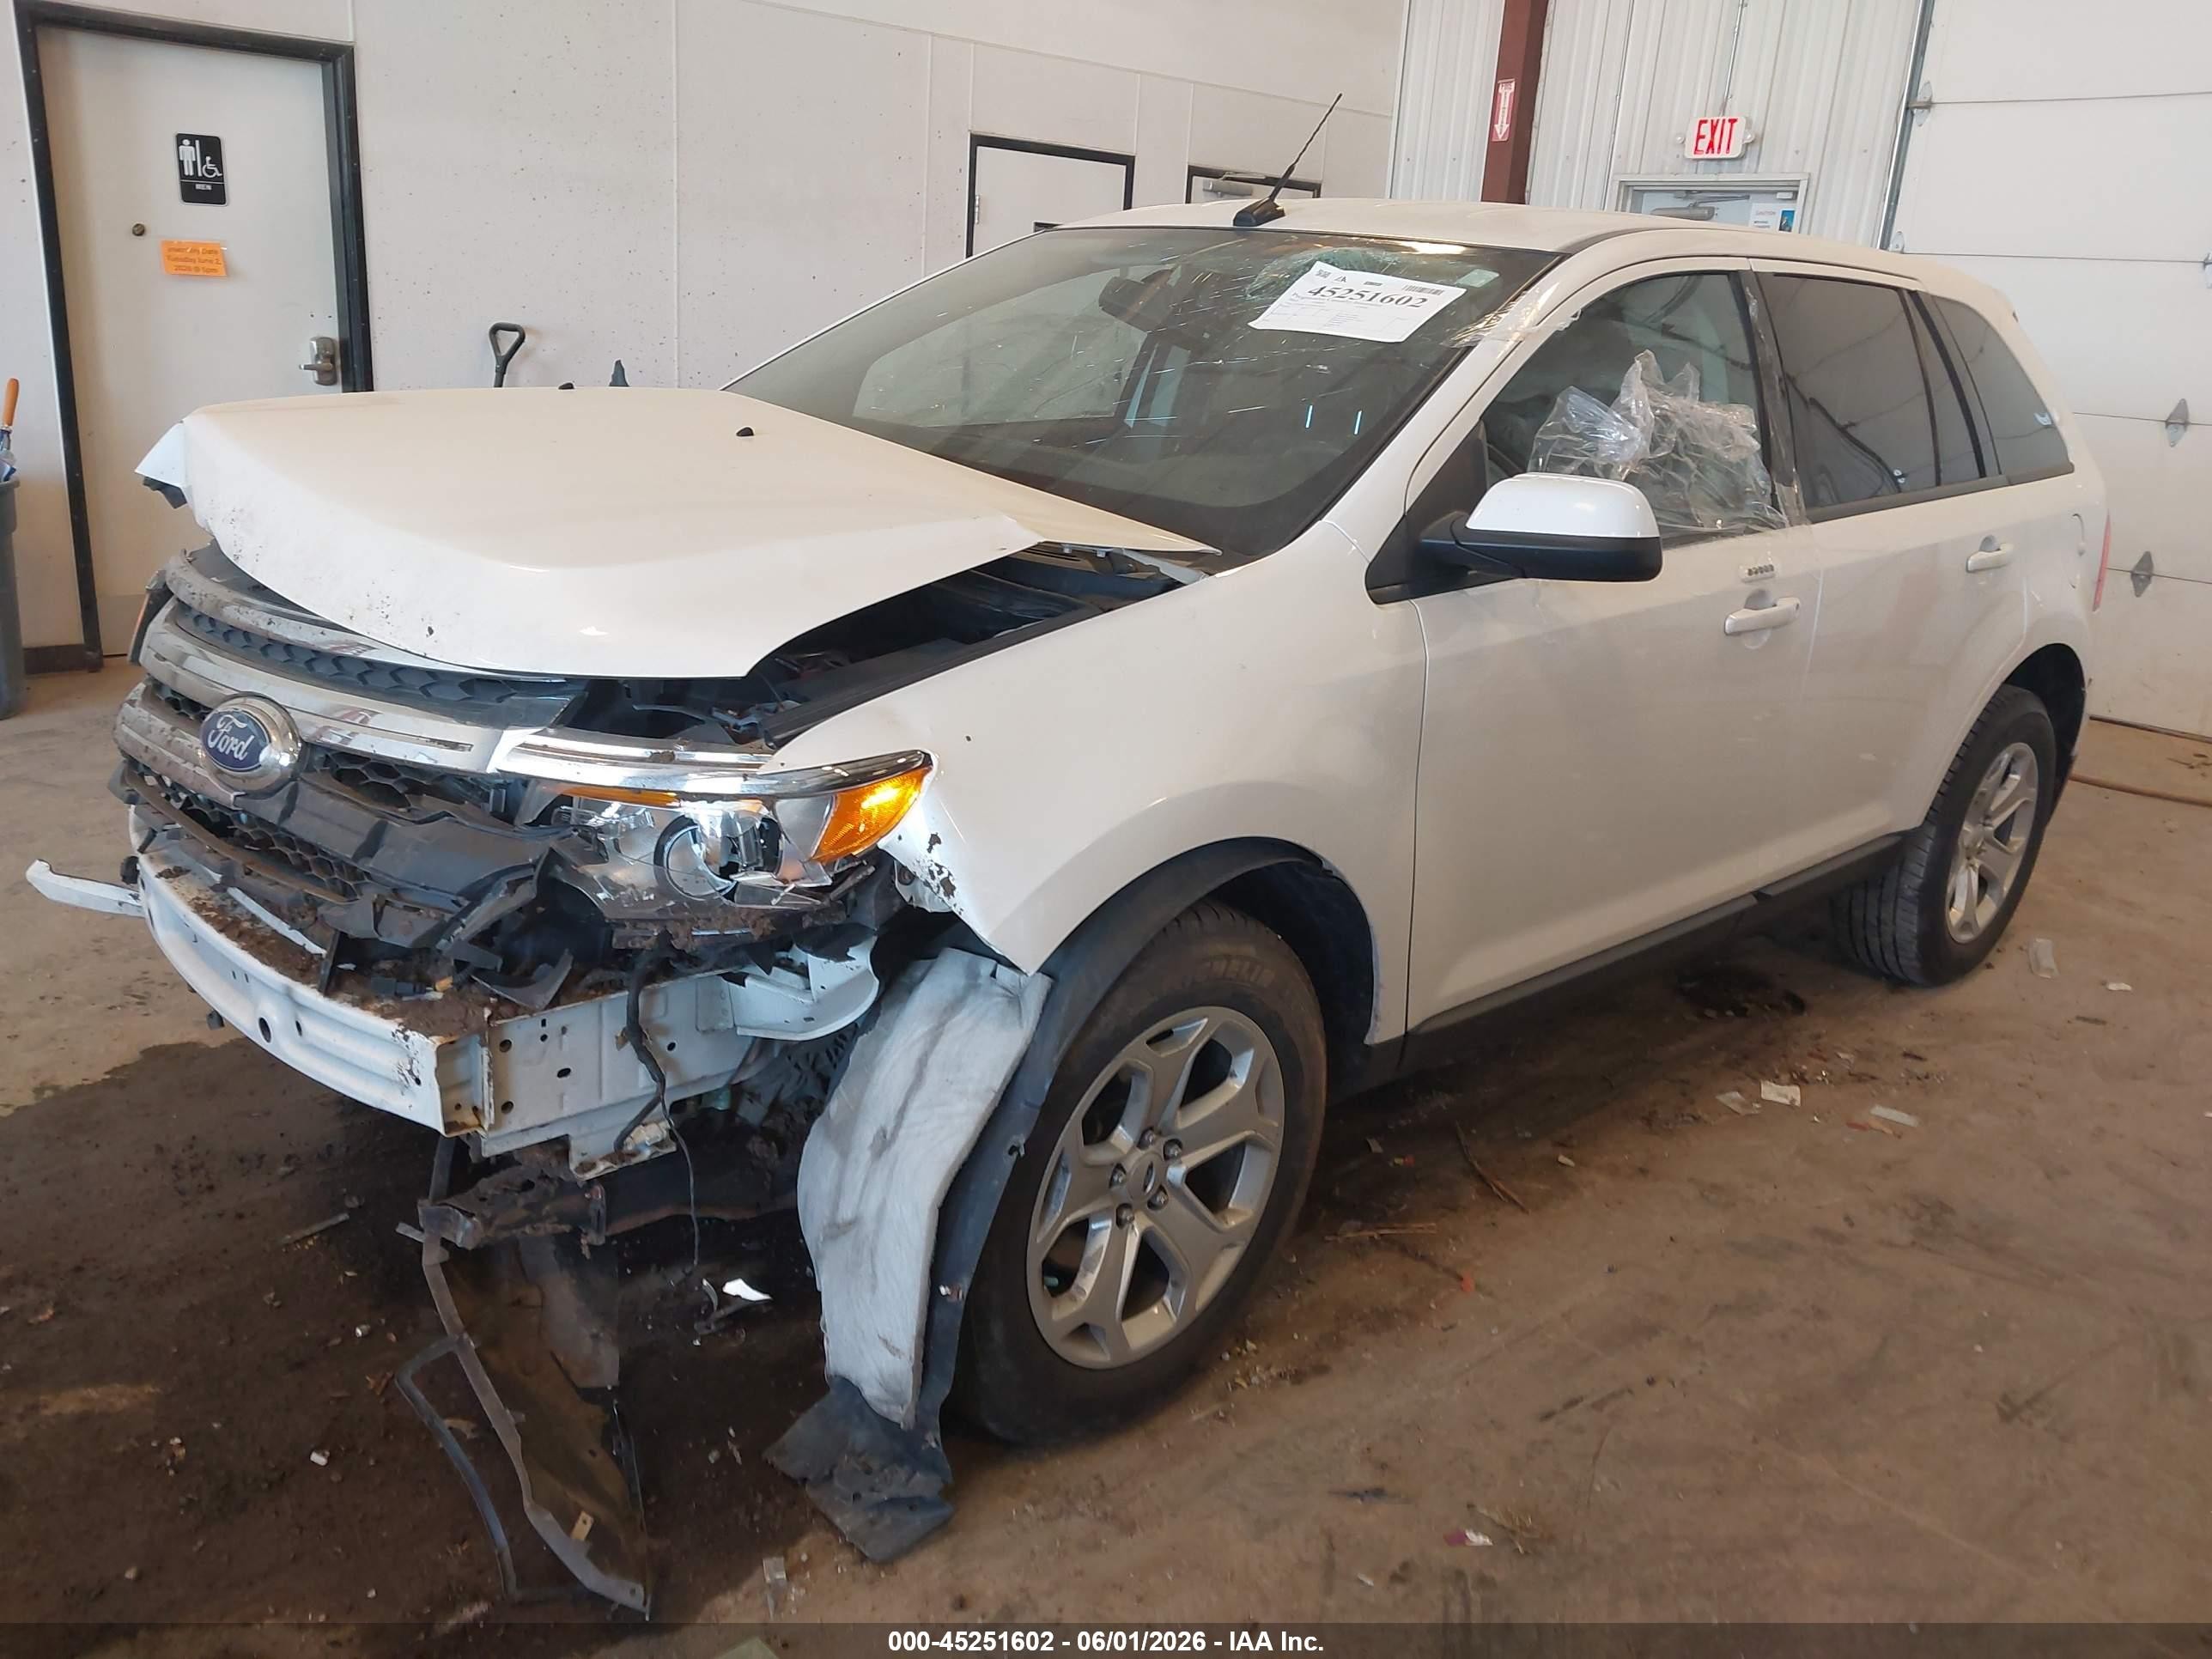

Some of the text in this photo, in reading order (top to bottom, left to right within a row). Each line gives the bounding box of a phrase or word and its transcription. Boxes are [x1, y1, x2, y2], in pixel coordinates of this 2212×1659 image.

[1693, 118, 1738, 155] EXIT
[1308, 285, 1428, 308] 45251602
[208, 714, 255, 761] Ford
